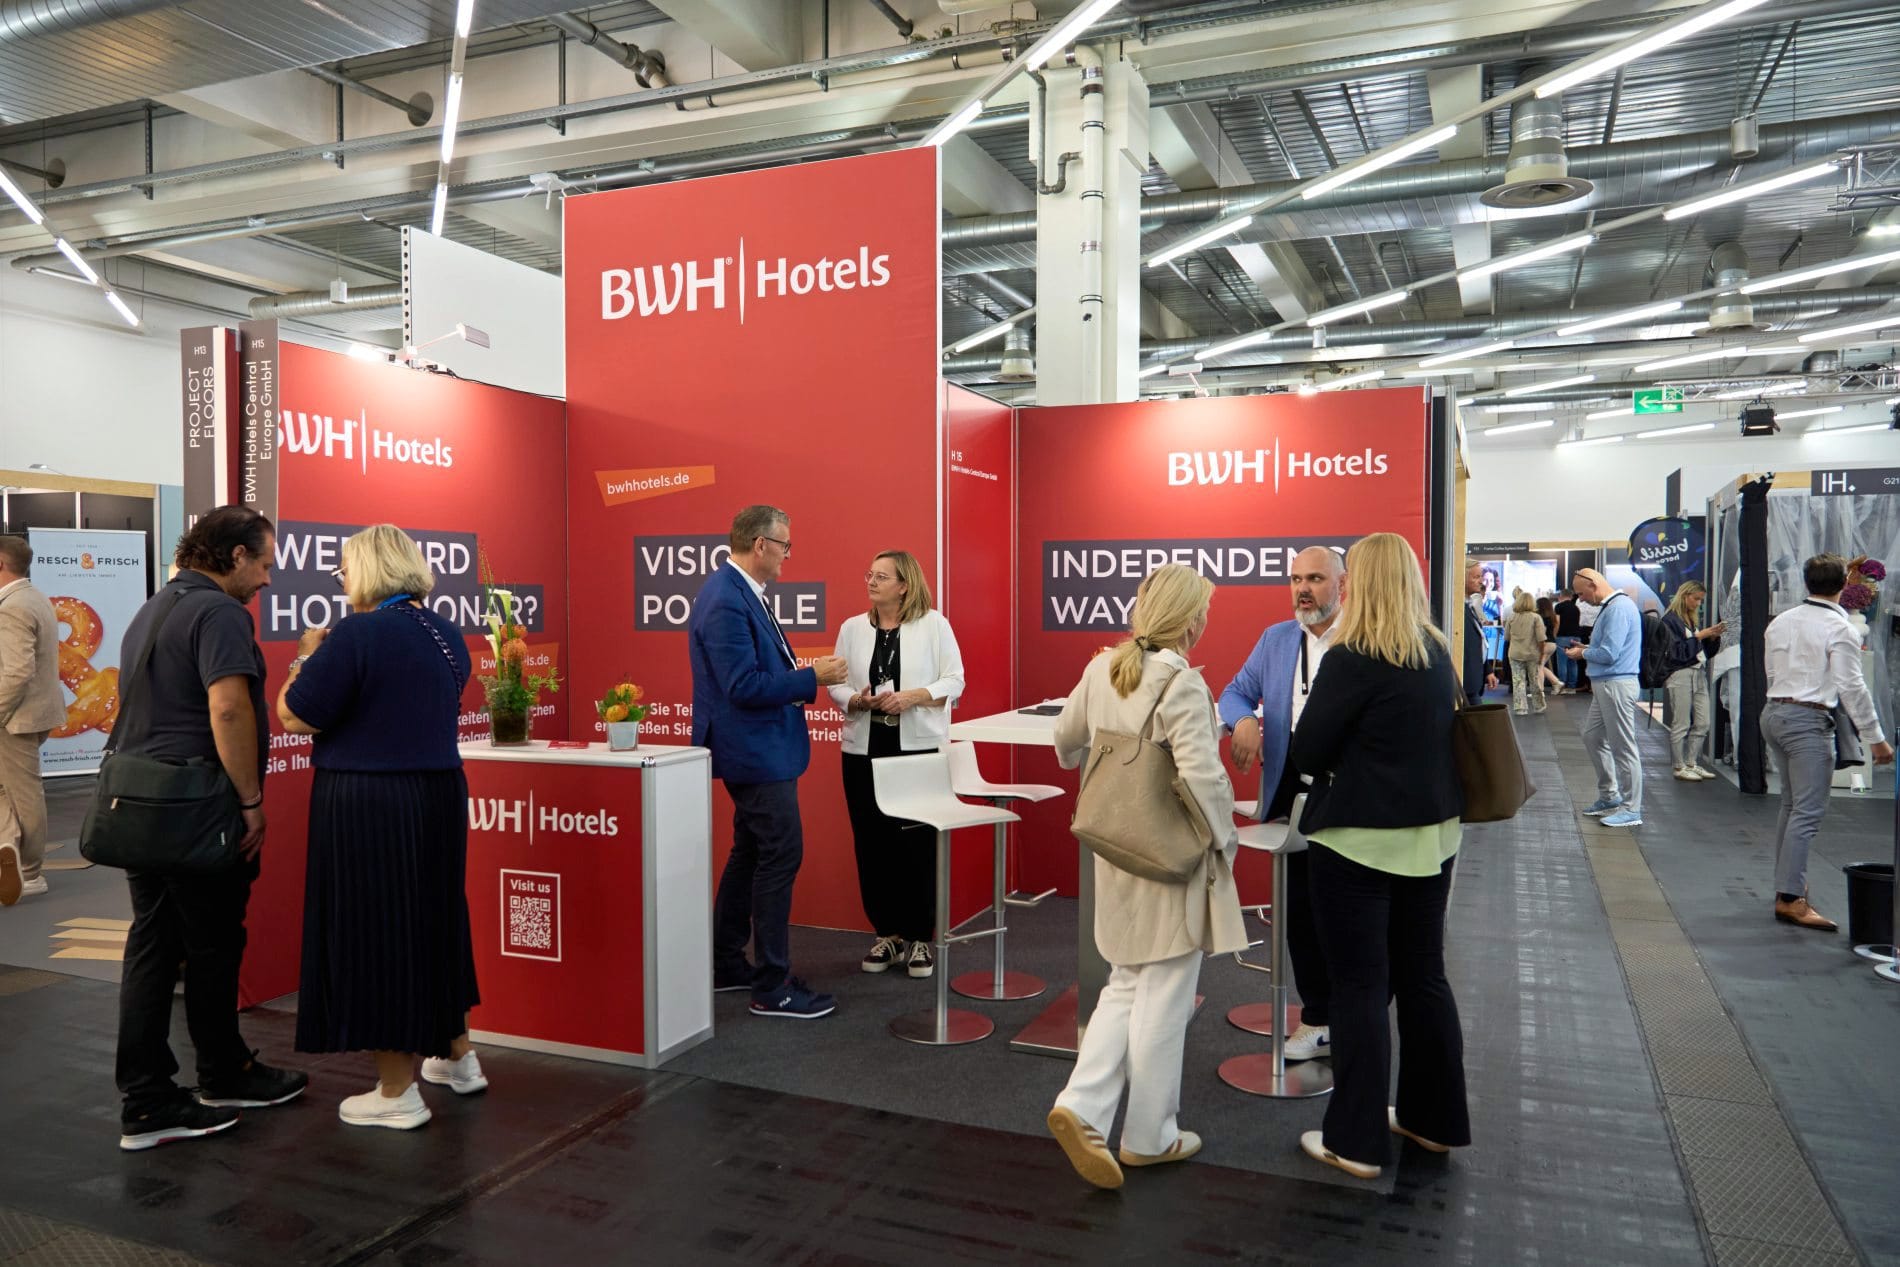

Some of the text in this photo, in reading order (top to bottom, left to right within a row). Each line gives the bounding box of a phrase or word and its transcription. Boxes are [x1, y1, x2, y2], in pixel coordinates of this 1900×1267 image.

[757, 246, 891, 298] Hotels
[193, 346, 207, 355] H13
[251, 339, 265, 348] H15
[188, 368, 200, 448] PROJECT
[202, 366, 215, 438] FLOORS
[260, 360, 275, 460] Europe GmbH
[244, 361, 257, 502] BWH Hotels Central
[373, 429, 453, 468] Hotels
[1288, 448, 1388, 478] Hotels
[607, 472, 690, 494] bwhhotels.de
[37, 556, 78, 565] RESCH
[97, 557, 139, 566] FRISCH
[274, 533, 352, 571] WE
[641, 544, 732, 576] VISIO
[650, 702, 670, 715] Sie
[540, 806, 618, 837] Hotels
[510, 879, 551, 894] Visit us
